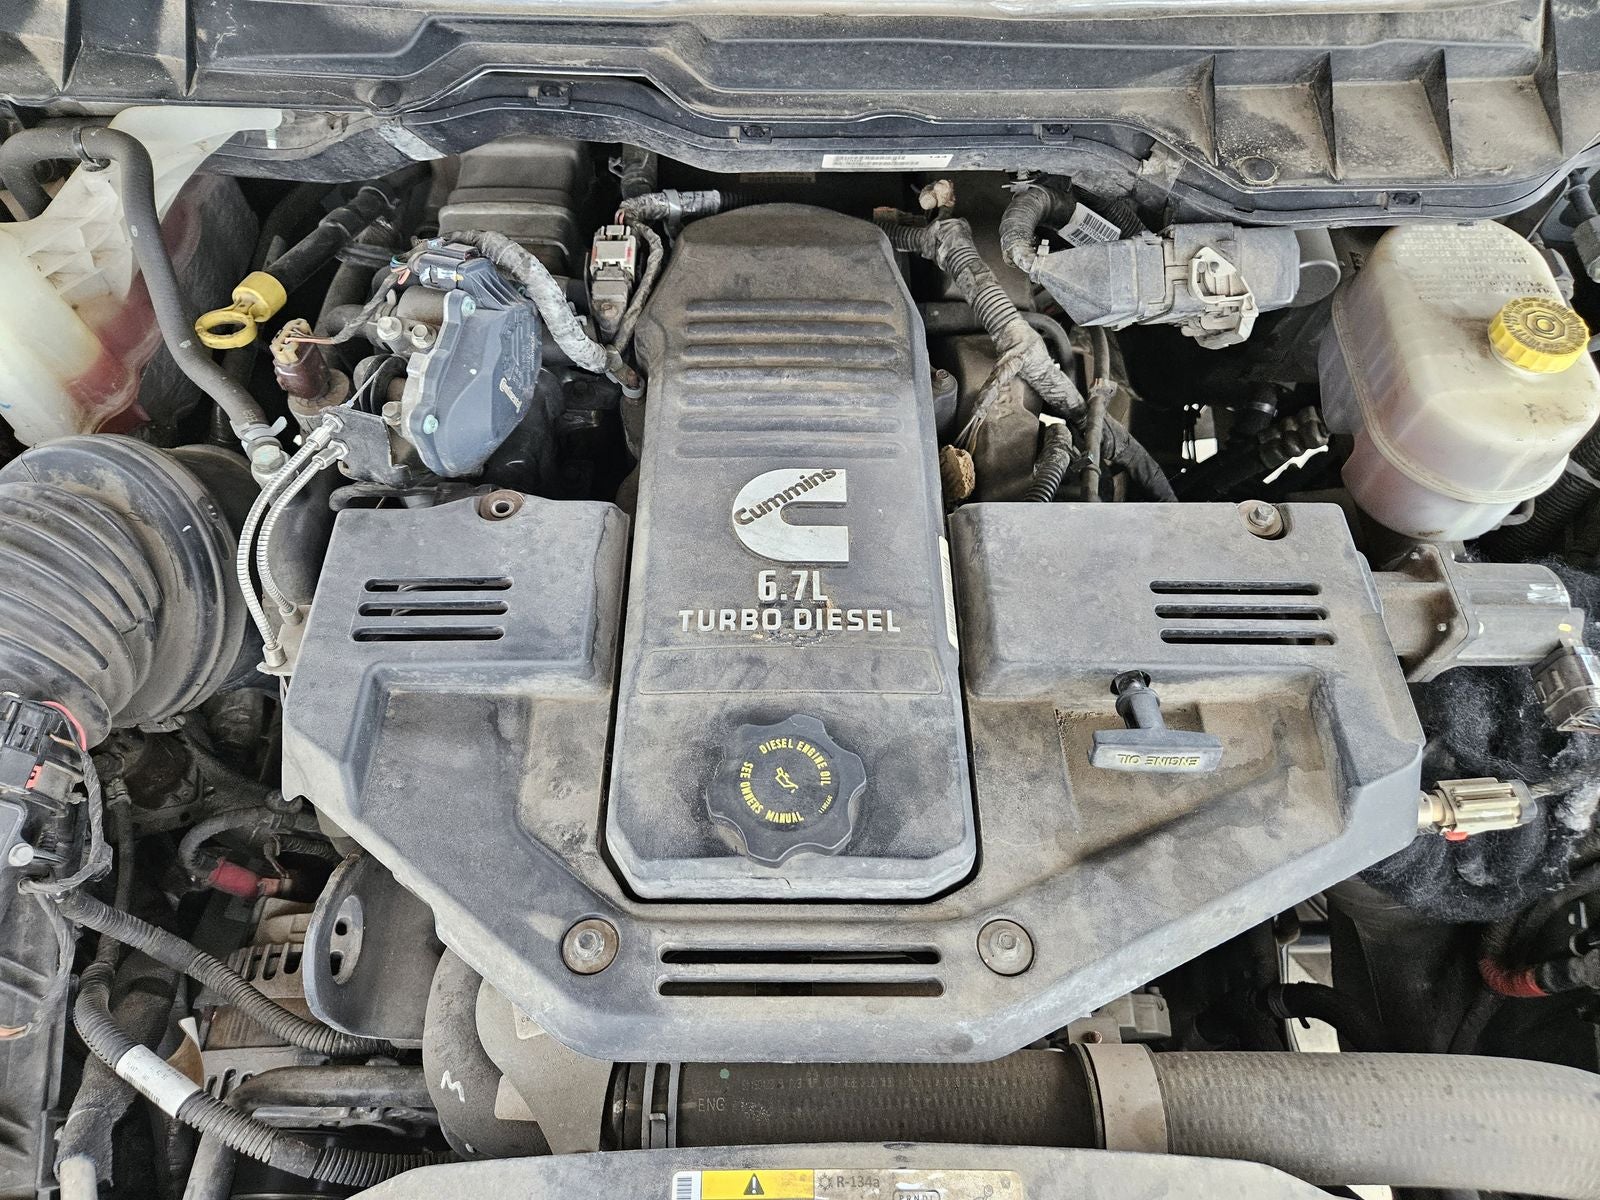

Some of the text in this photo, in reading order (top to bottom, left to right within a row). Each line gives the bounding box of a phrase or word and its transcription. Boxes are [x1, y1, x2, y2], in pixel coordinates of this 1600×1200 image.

[733, 468, 837, 525] Cummins
[757, 570, 828, 602] 6.7L
[678, 608, 901, 633] TURBO DIESEL
[758, 737, 831, 786] DIESEL ENGINE OIL
[1117, 753, 1201, 766] ENGINE OIL
[739, 761, 804, 824] SEE OWNERS MANUAL
[698, 1097, 726, 1113] ENG
[836, 1175, 880, 1189] R-134a
